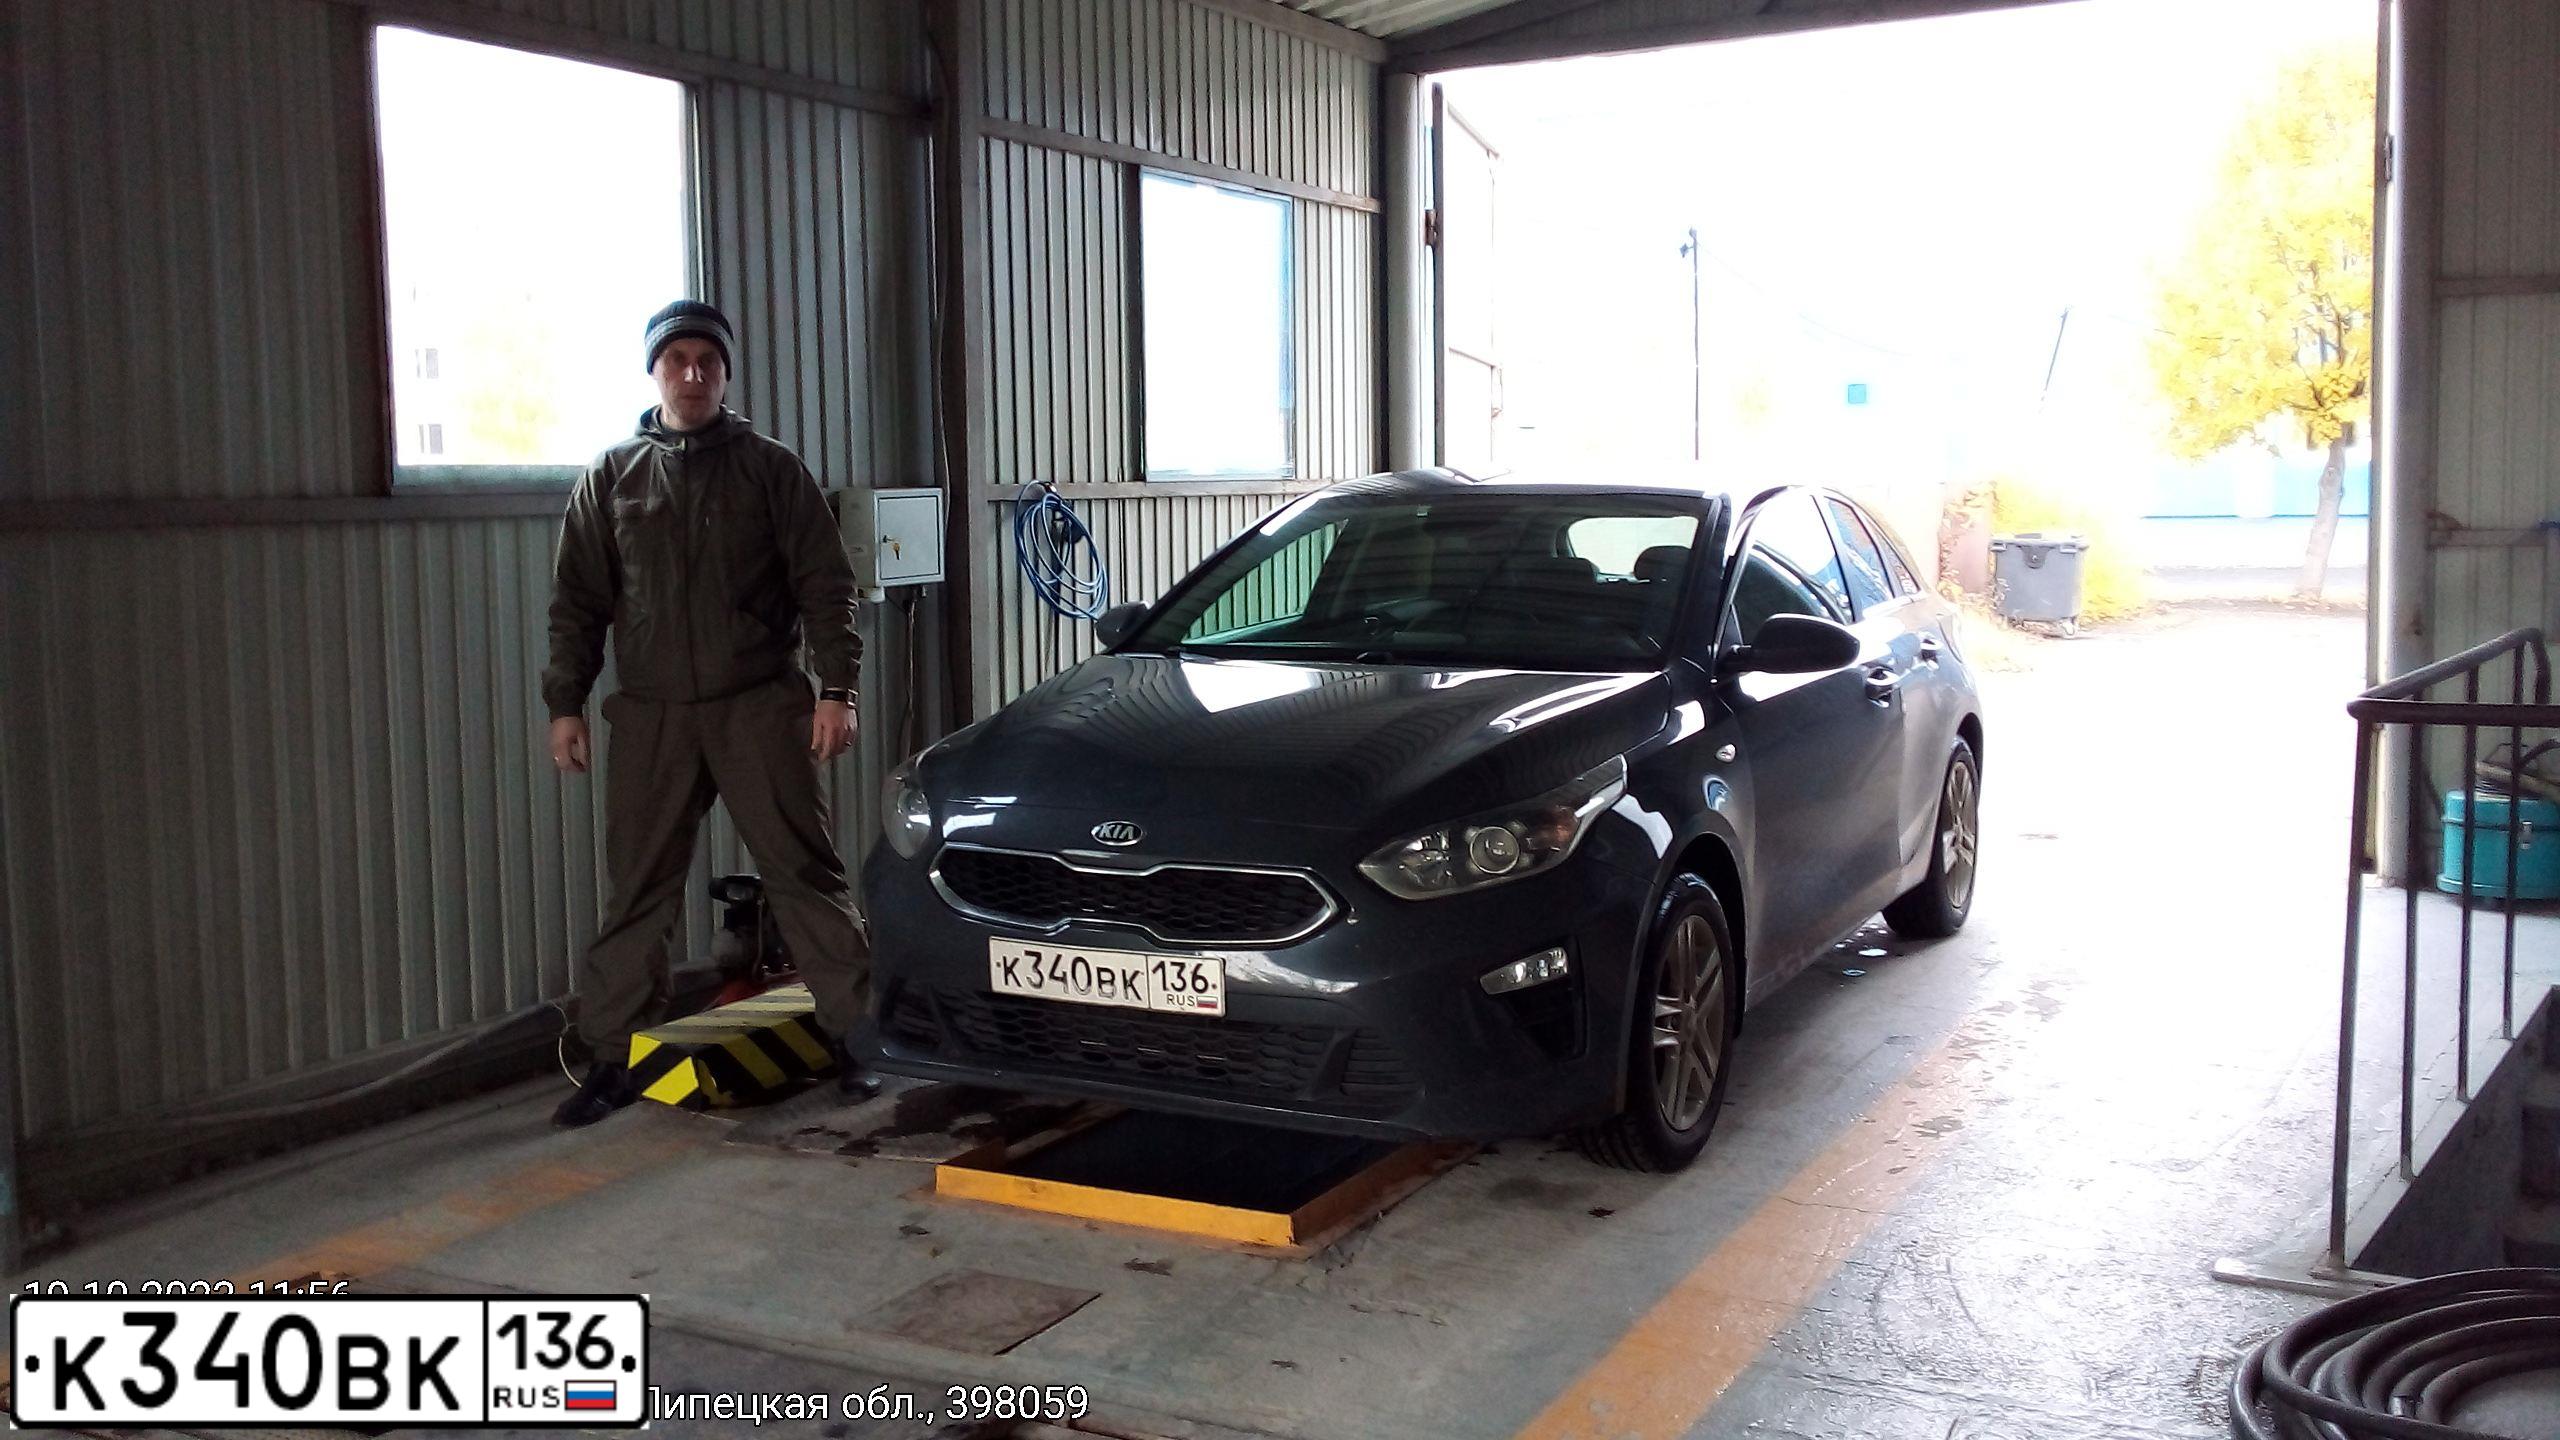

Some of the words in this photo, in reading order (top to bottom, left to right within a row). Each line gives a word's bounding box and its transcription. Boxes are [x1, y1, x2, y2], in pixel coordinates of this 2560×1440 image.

[1099, 824, 1134, 840] KIA
[1002, 950, 1143, 1001] К340ВК
[1151, 960, 1209, 994] 136
[1166, 993, 1195, 1007] RUS
